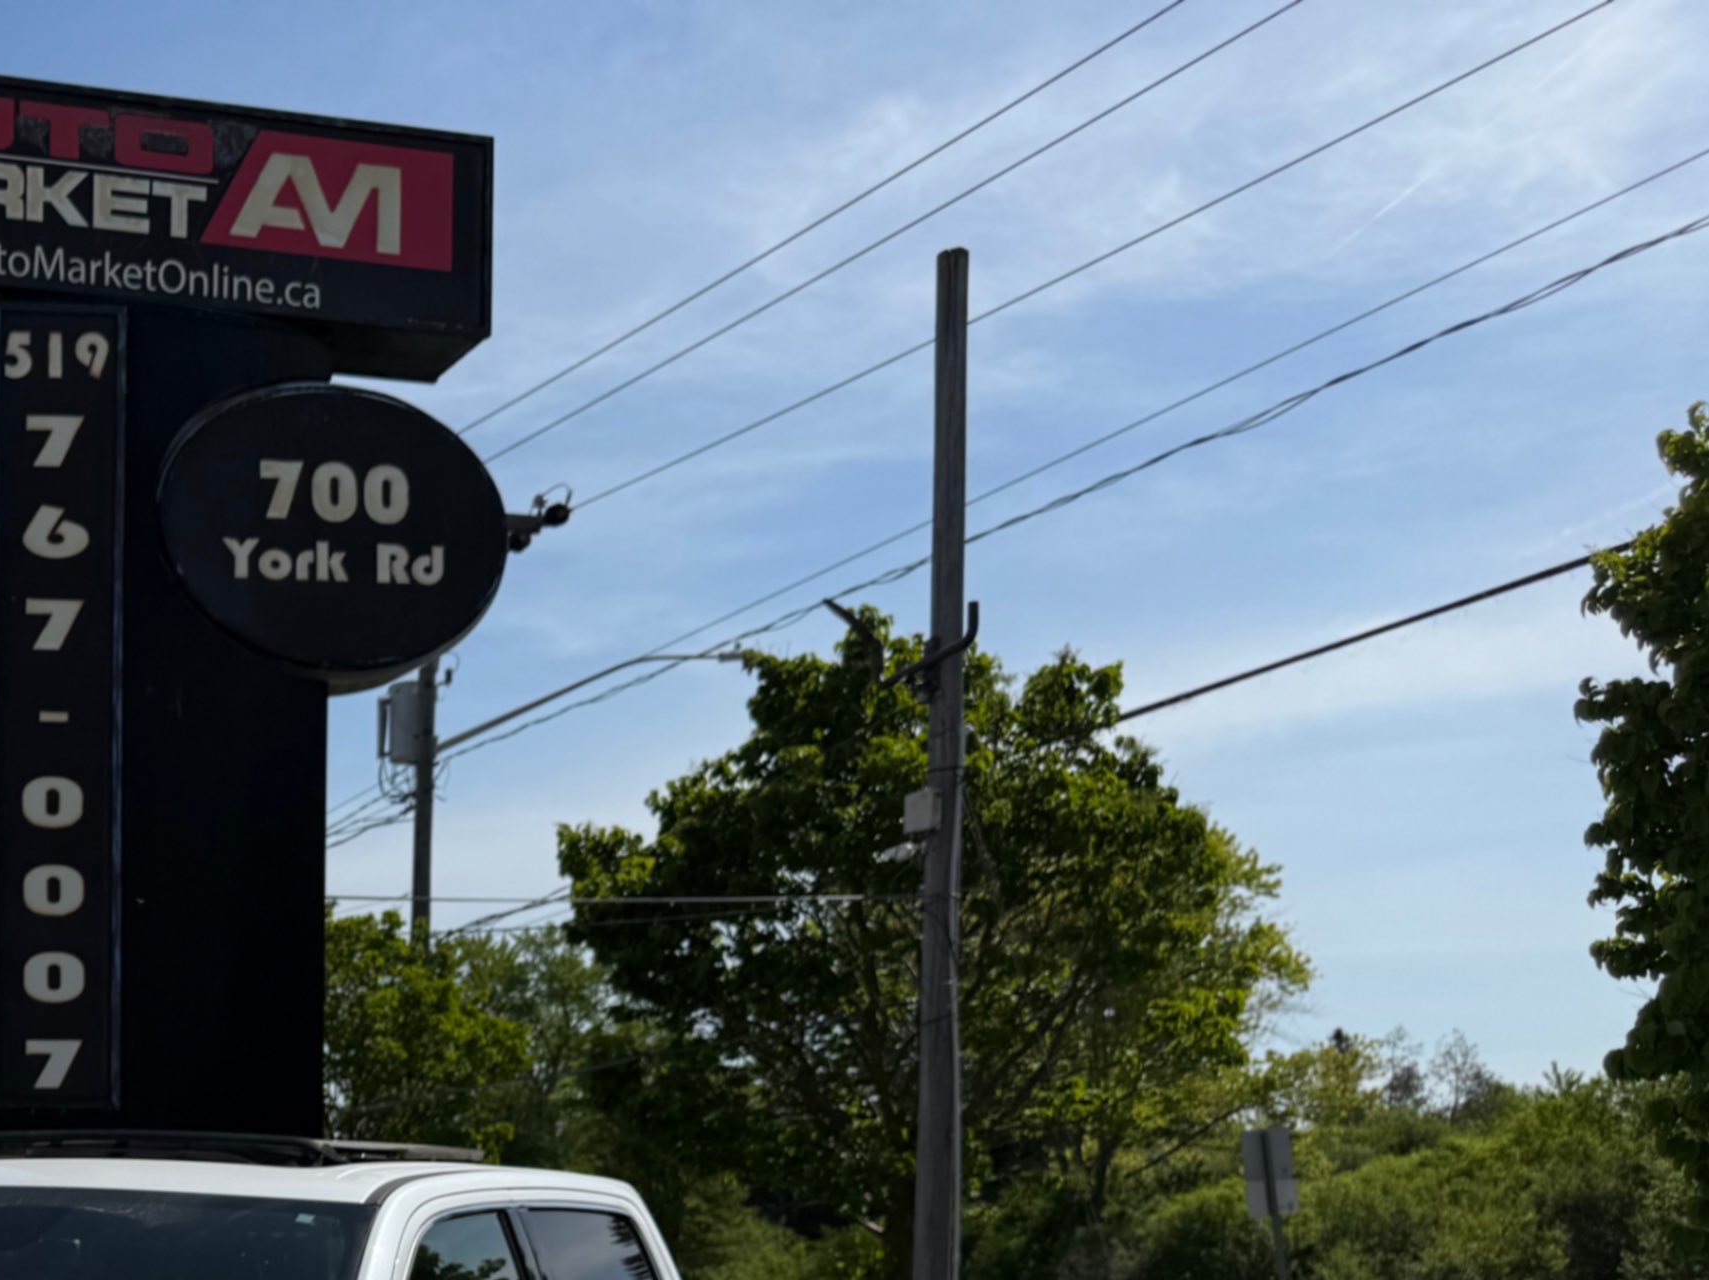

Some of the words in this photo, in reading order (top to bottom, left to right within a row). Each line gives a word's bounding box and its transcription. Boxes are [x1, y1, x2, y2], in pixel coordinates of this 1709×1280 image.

[3, 331, 109, 380] 519
[259, 459, 410, 525] 700
[222, 536, 350, 584] York
[375, 542, 446, 586] Rd
